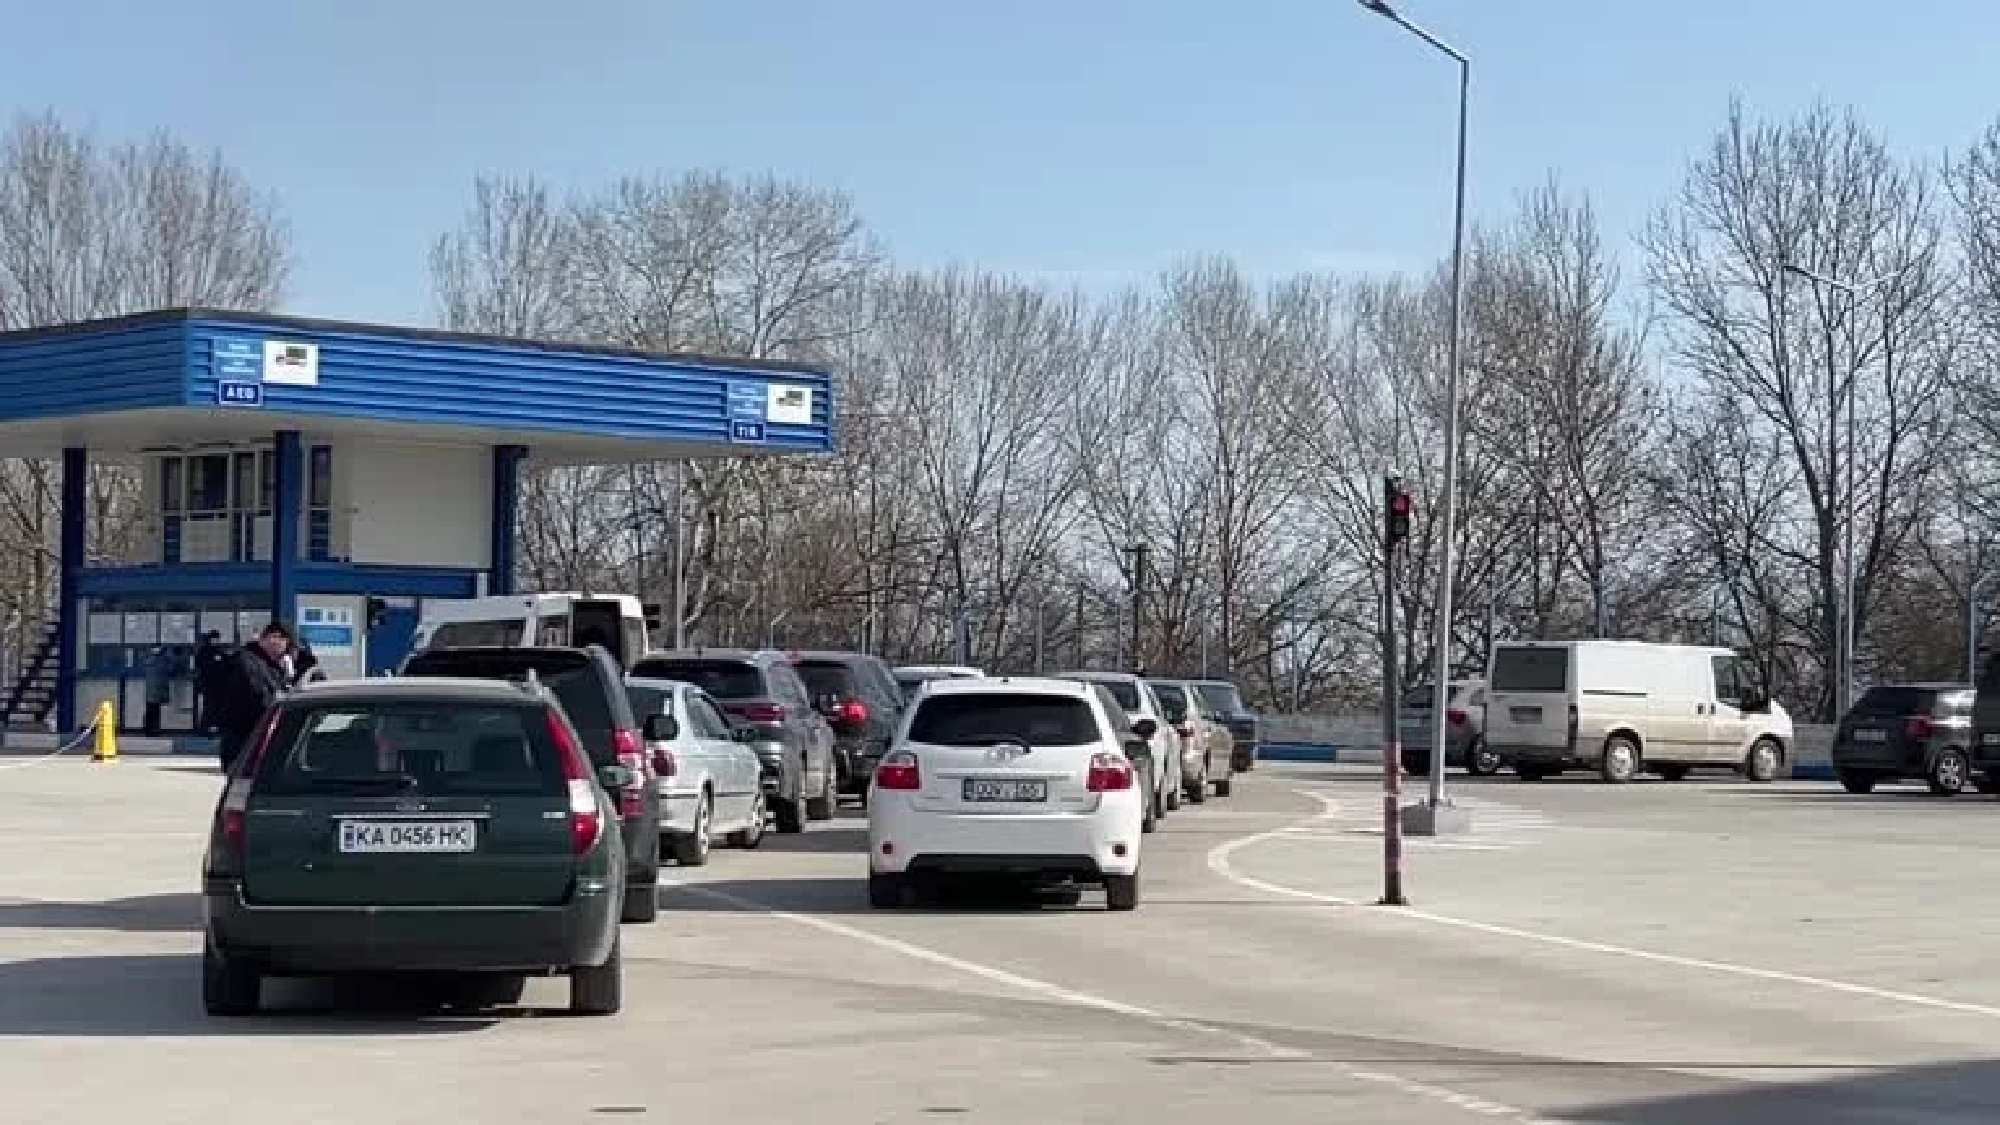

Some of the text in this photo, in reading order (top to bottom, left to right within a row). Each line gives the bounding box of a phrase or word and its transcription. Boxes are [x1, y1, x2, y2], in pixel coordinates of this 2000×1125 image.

[356, 827, 384, 845] KA
[390, 827, 436, 845] 0456
[439, 827, 468, 845] HK
